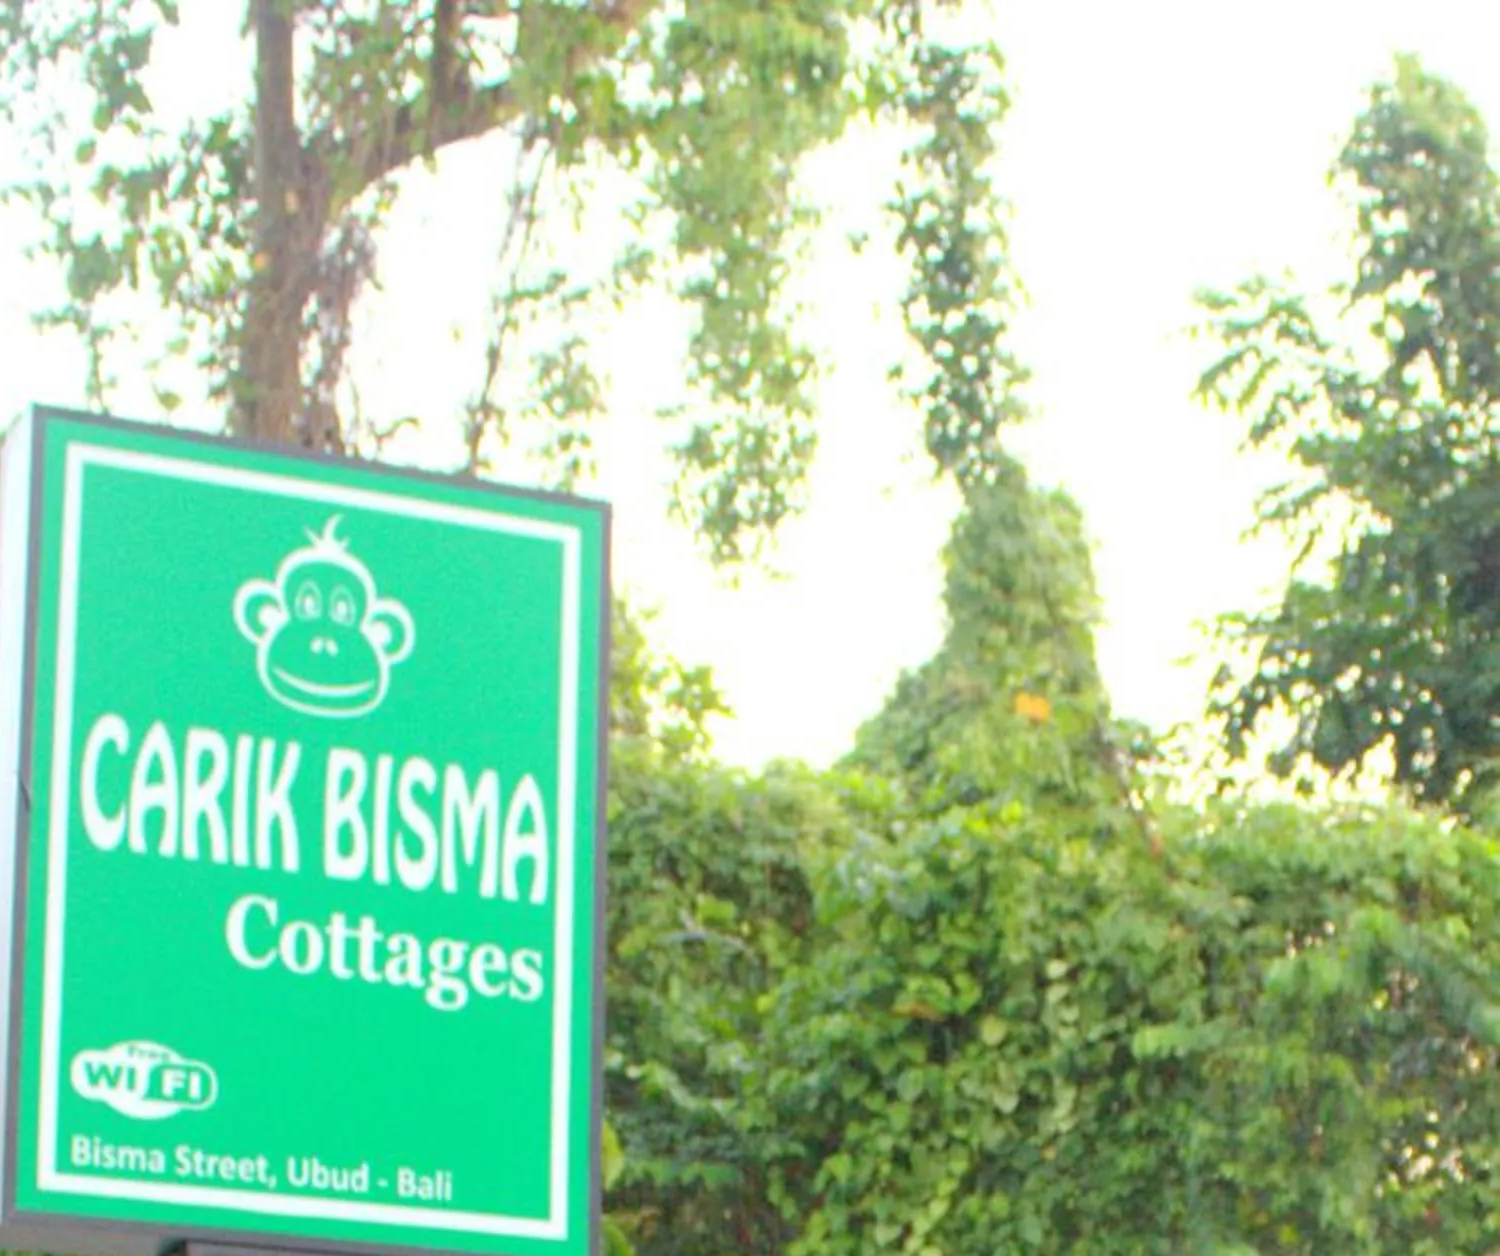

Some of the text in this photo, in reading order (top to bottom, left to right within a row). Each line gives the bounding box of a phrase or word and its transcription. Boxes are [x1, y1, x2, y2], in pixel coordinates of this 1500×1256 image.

[79, 712, 550, 905] CARIK BISMA
[224, 894, 544, 1011] Cottages
[71, 1135, 166, 1173] Bisma
[175, 1145, 278, 1189] Street,
[287, 1156, 370, 1193] Ubud
[397, 1167, 453, 1201] Bali
